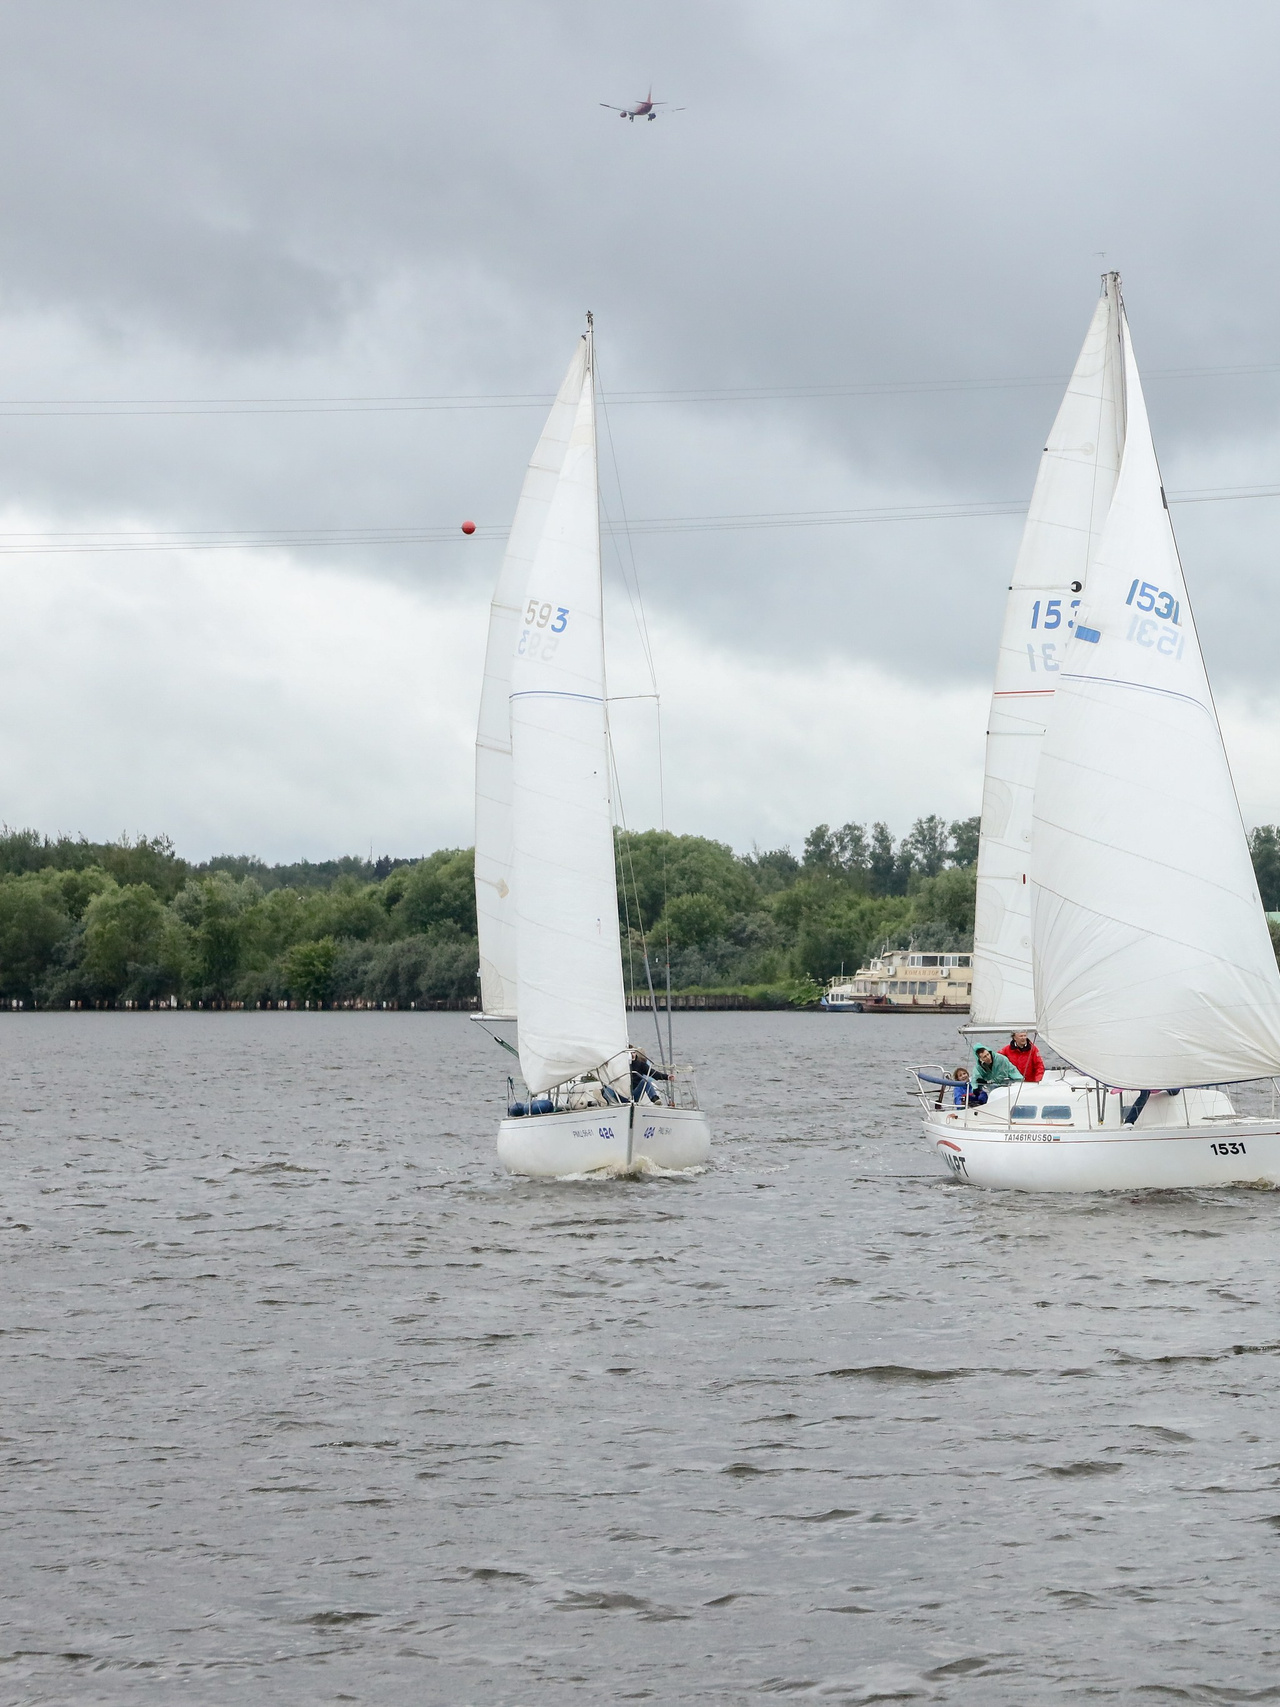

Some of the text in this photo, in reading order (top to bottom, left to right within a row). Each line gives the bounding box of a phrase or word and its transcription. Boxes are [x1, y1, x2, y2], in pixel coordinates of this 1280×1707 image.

[1125, 578, 1180, 625] 1531
[524, 599, 569, 633] 593
[598, 1127, 616, 1140] 424
[1210, 1142, 1247, 1156] 1531
